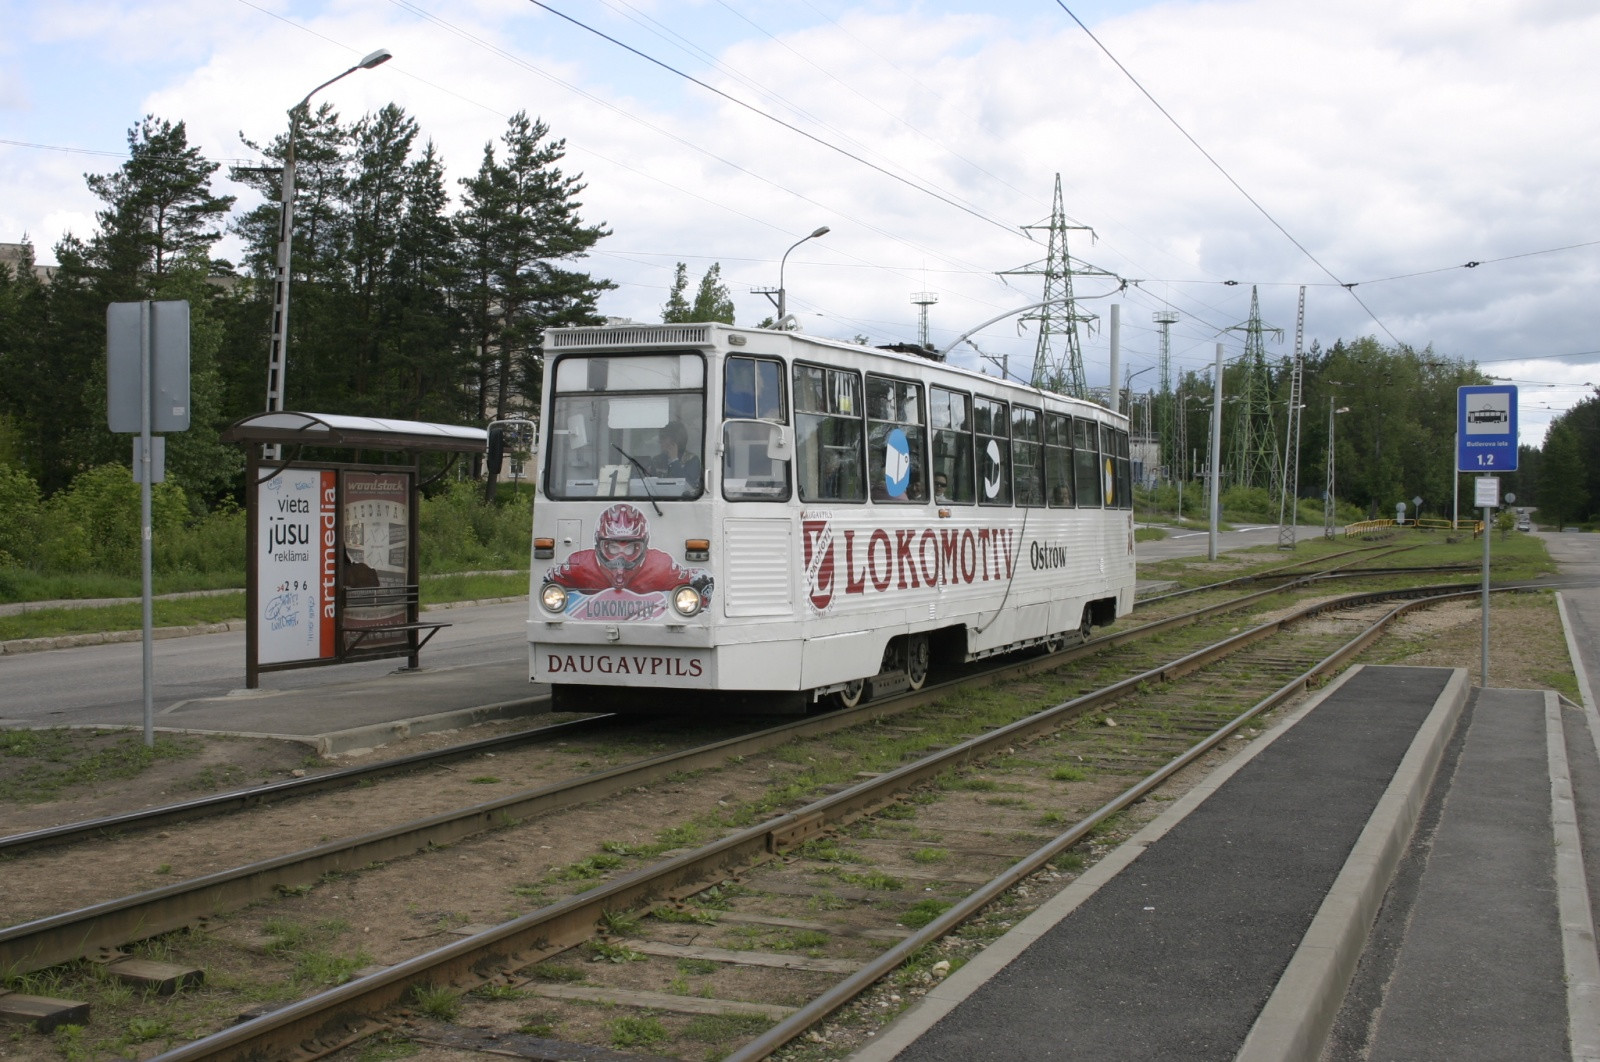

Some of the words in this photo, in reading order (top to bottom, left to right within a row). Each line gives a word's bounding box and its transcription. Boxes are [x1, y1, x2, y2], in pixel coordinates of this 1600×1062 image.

[1477, 454, 1494, 466] 1,2
[348, 479, 404, 491] woodstock
[608, 469, 619, 497] 1
[277, 494, 309, 513] vieta
[268, 516, 309, 554] jūsu
[274, 550, 309, 562] reklāmai
[321, 487, 336, 618] artmedia
[843, 527, 1014, 595] LOKOMOTIV
[1030, 540, 1068, 571] Ostrów
[586, 599, 656, 618] LOKOMOTIV
[547, 654, 703, 677] DAUGAVPILS
